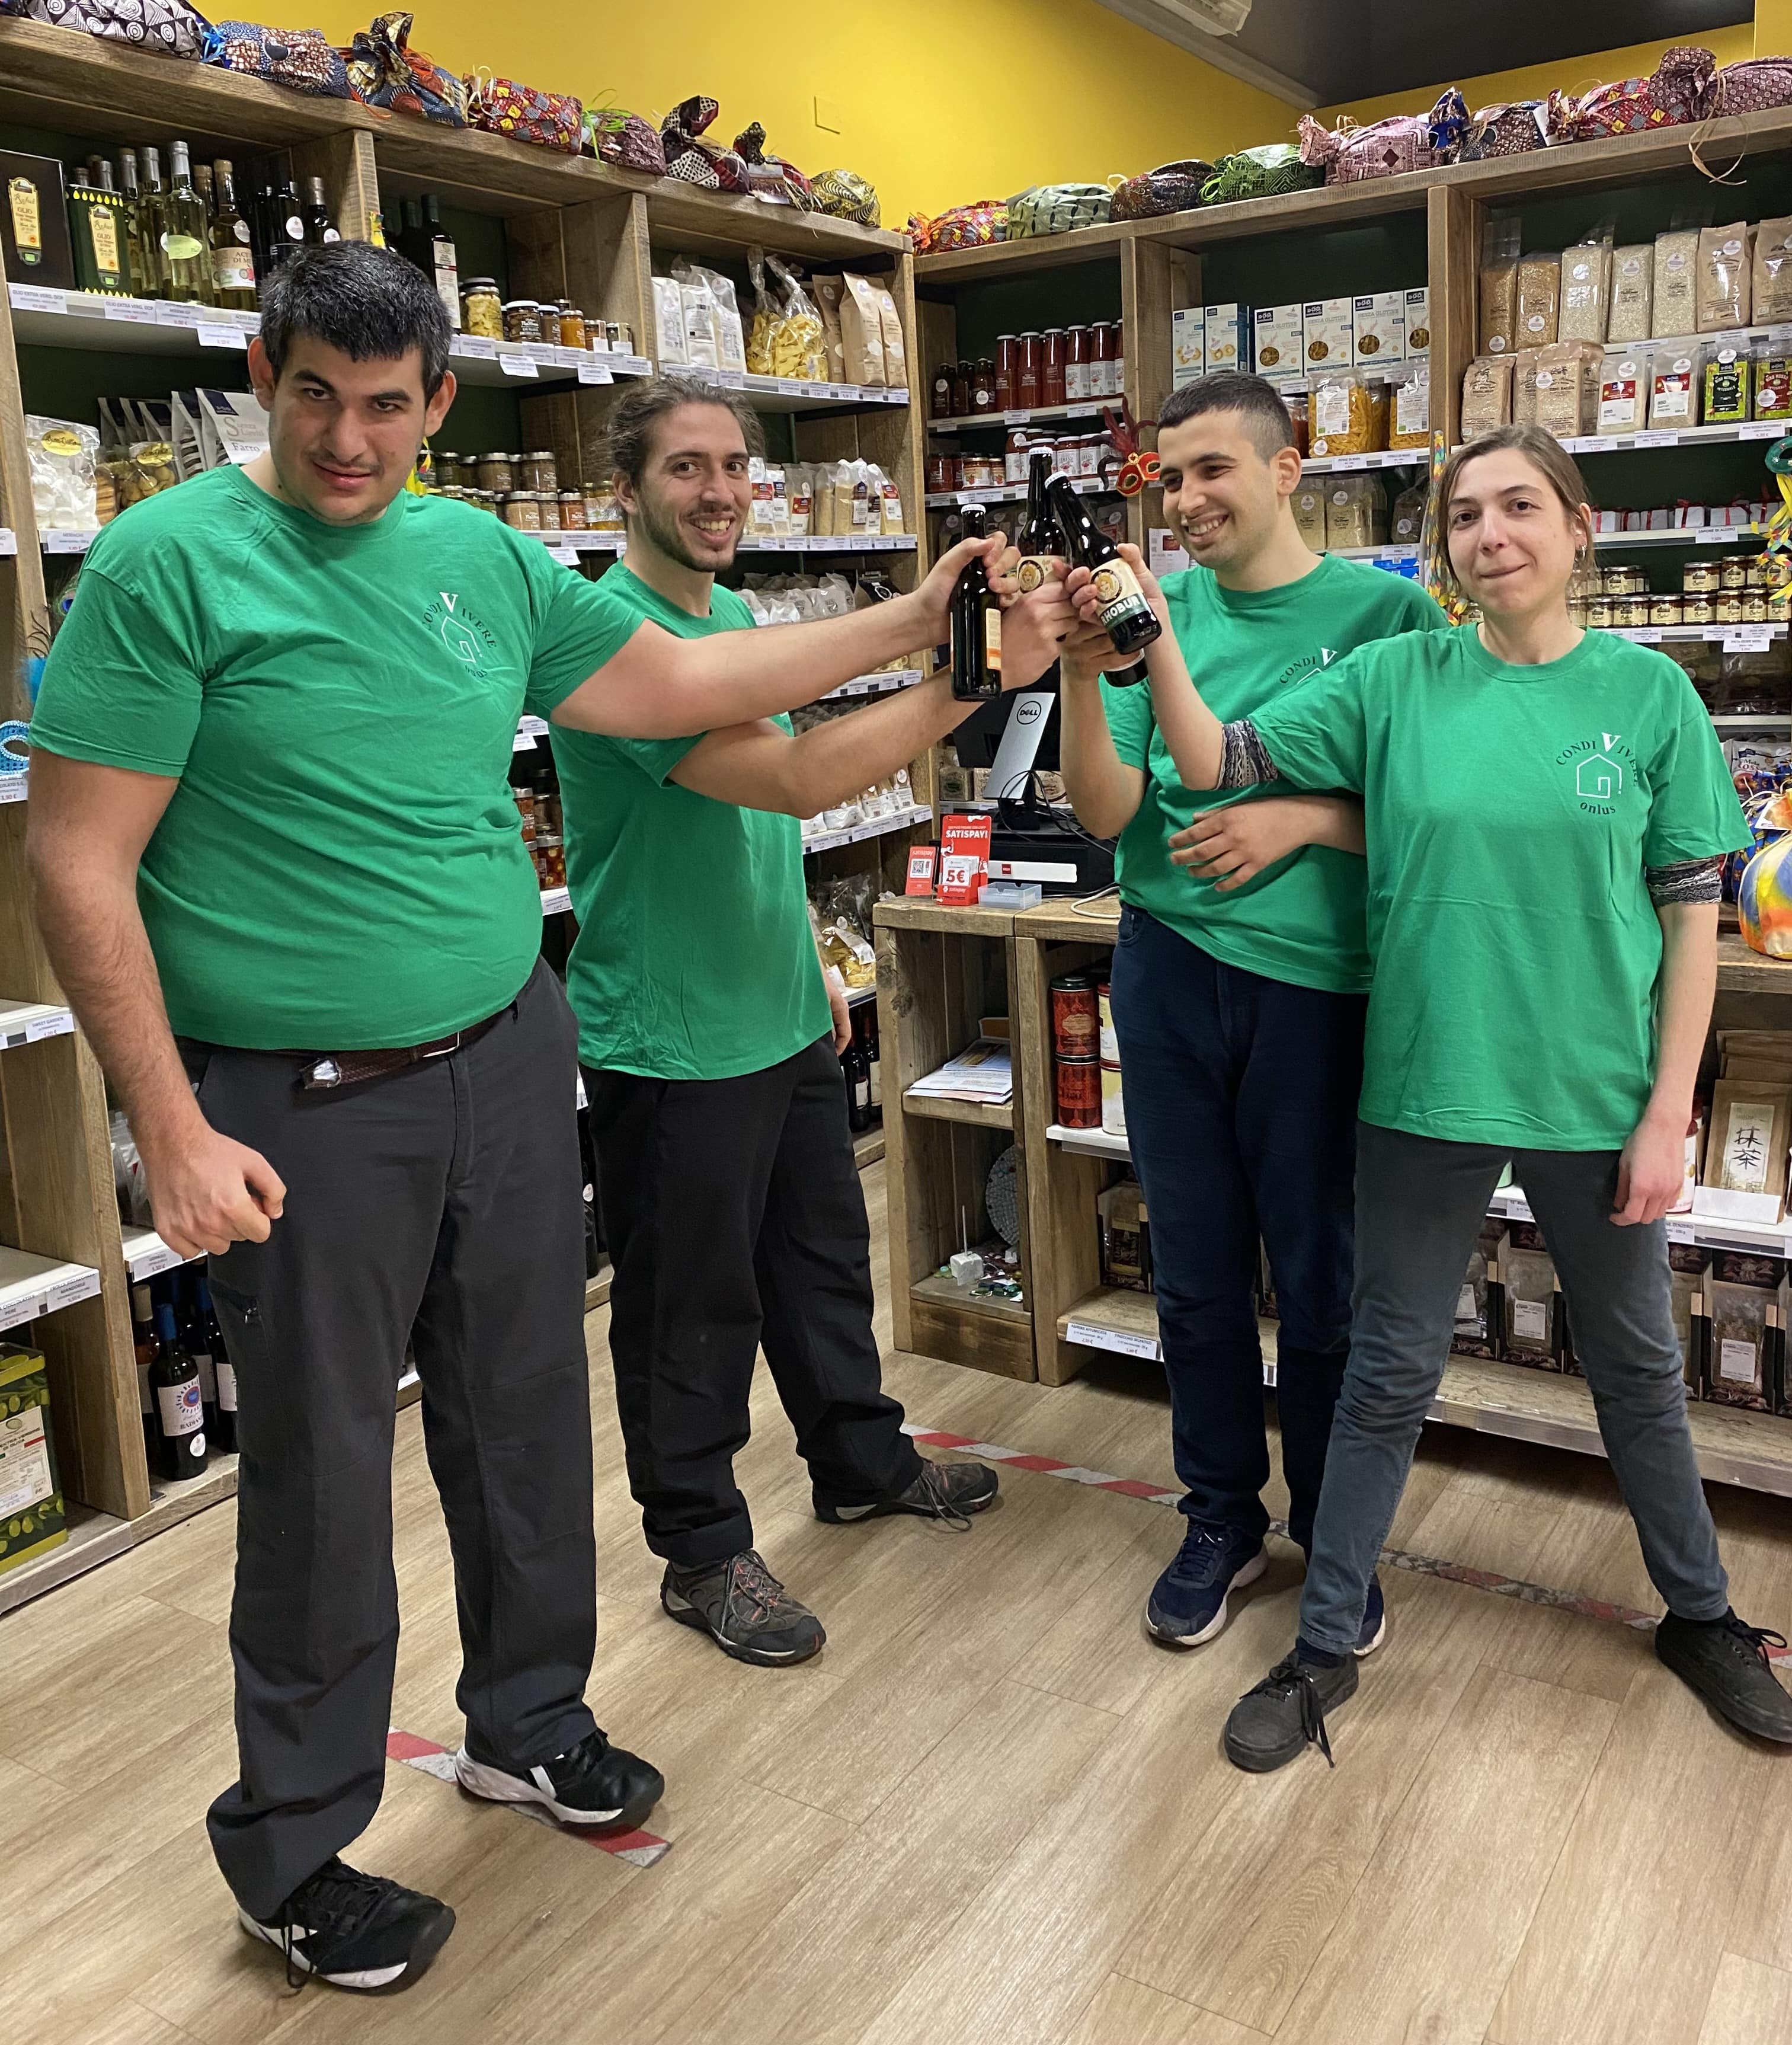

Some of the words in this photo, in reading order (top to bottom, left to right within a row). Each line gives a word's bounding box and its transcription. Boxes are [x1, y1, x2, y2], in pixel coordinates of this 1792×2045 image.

[232, 442, 261, 452] Farro
[1580, 802, 1615, 814] onlus
[946, 830, 988, 839] SATISPAY!
[946, 870, 965, 883] 5€
[1732, 1126, 1764, 1170] 抹茶
